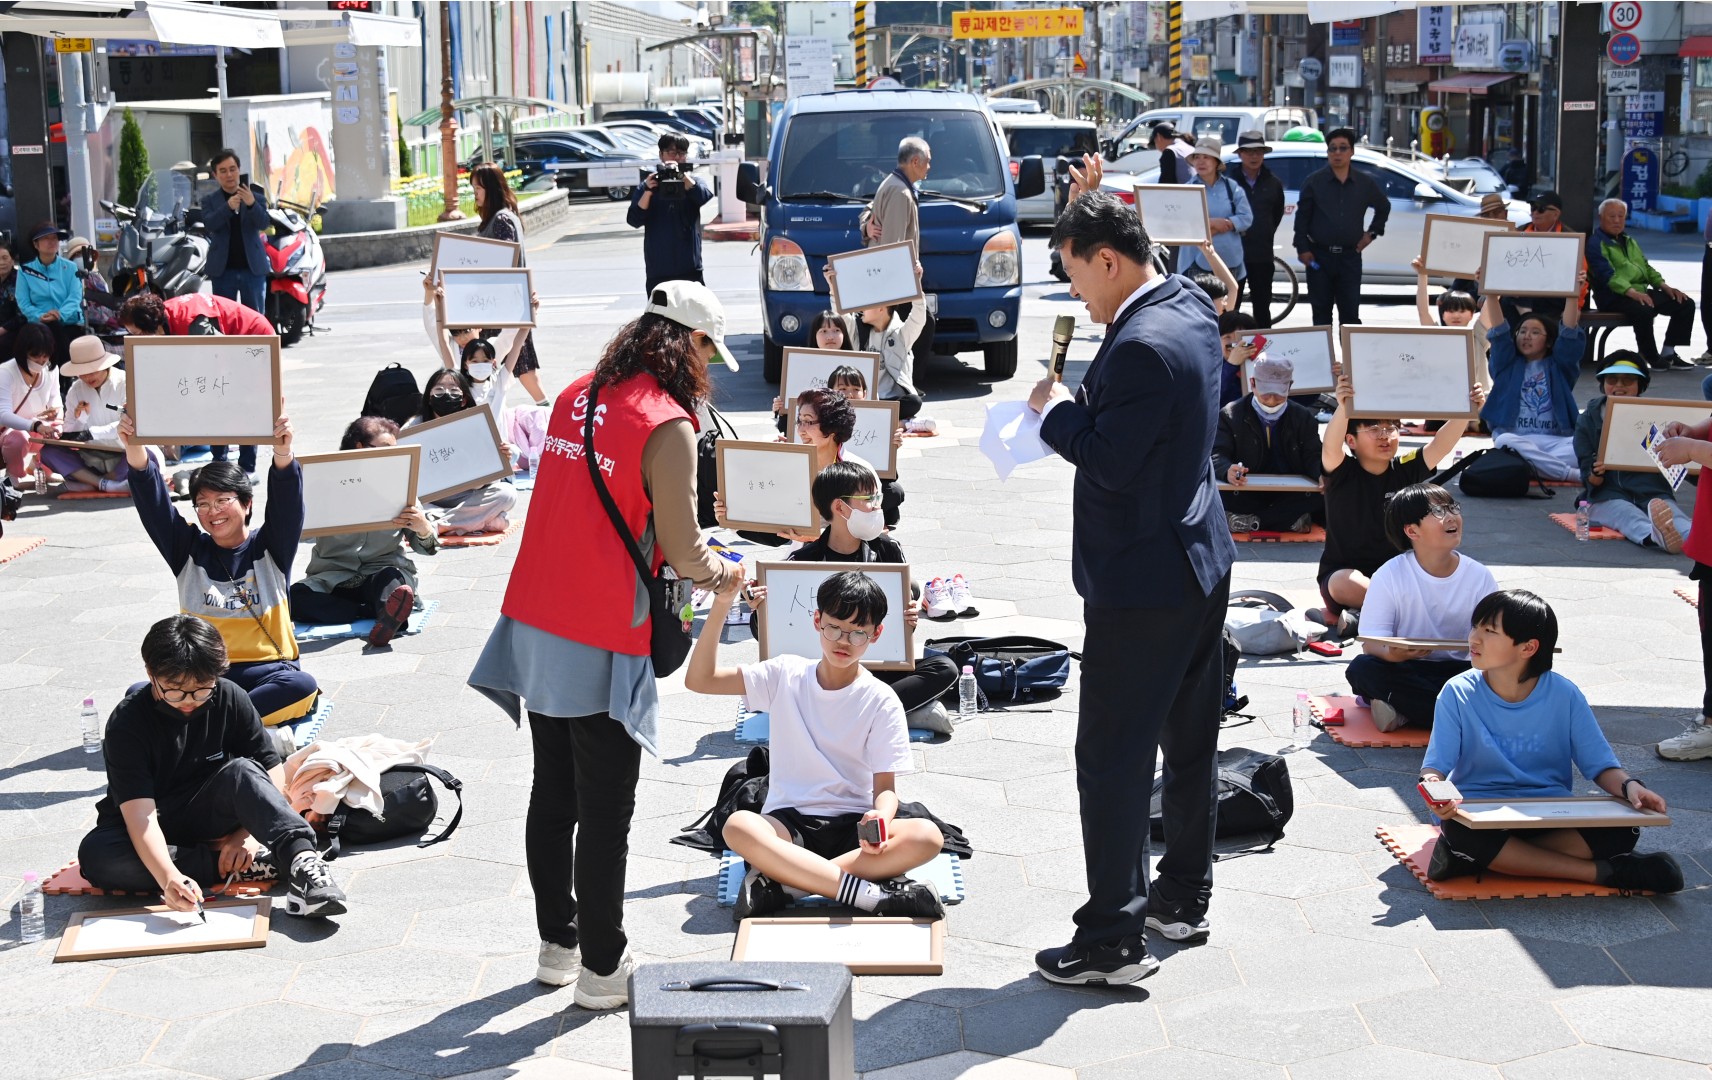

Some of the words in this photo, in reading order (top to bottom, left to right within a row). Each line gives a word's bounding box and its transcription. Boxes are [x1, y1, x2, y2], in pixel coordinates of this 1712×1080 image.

[1616, 7, 1635, 22] 30
[1611, 69, 1637, 79] 견인지역
[1630, 165, 1649, 210] 컴퓨터
[1517, 417, 1538, 429] REAL
